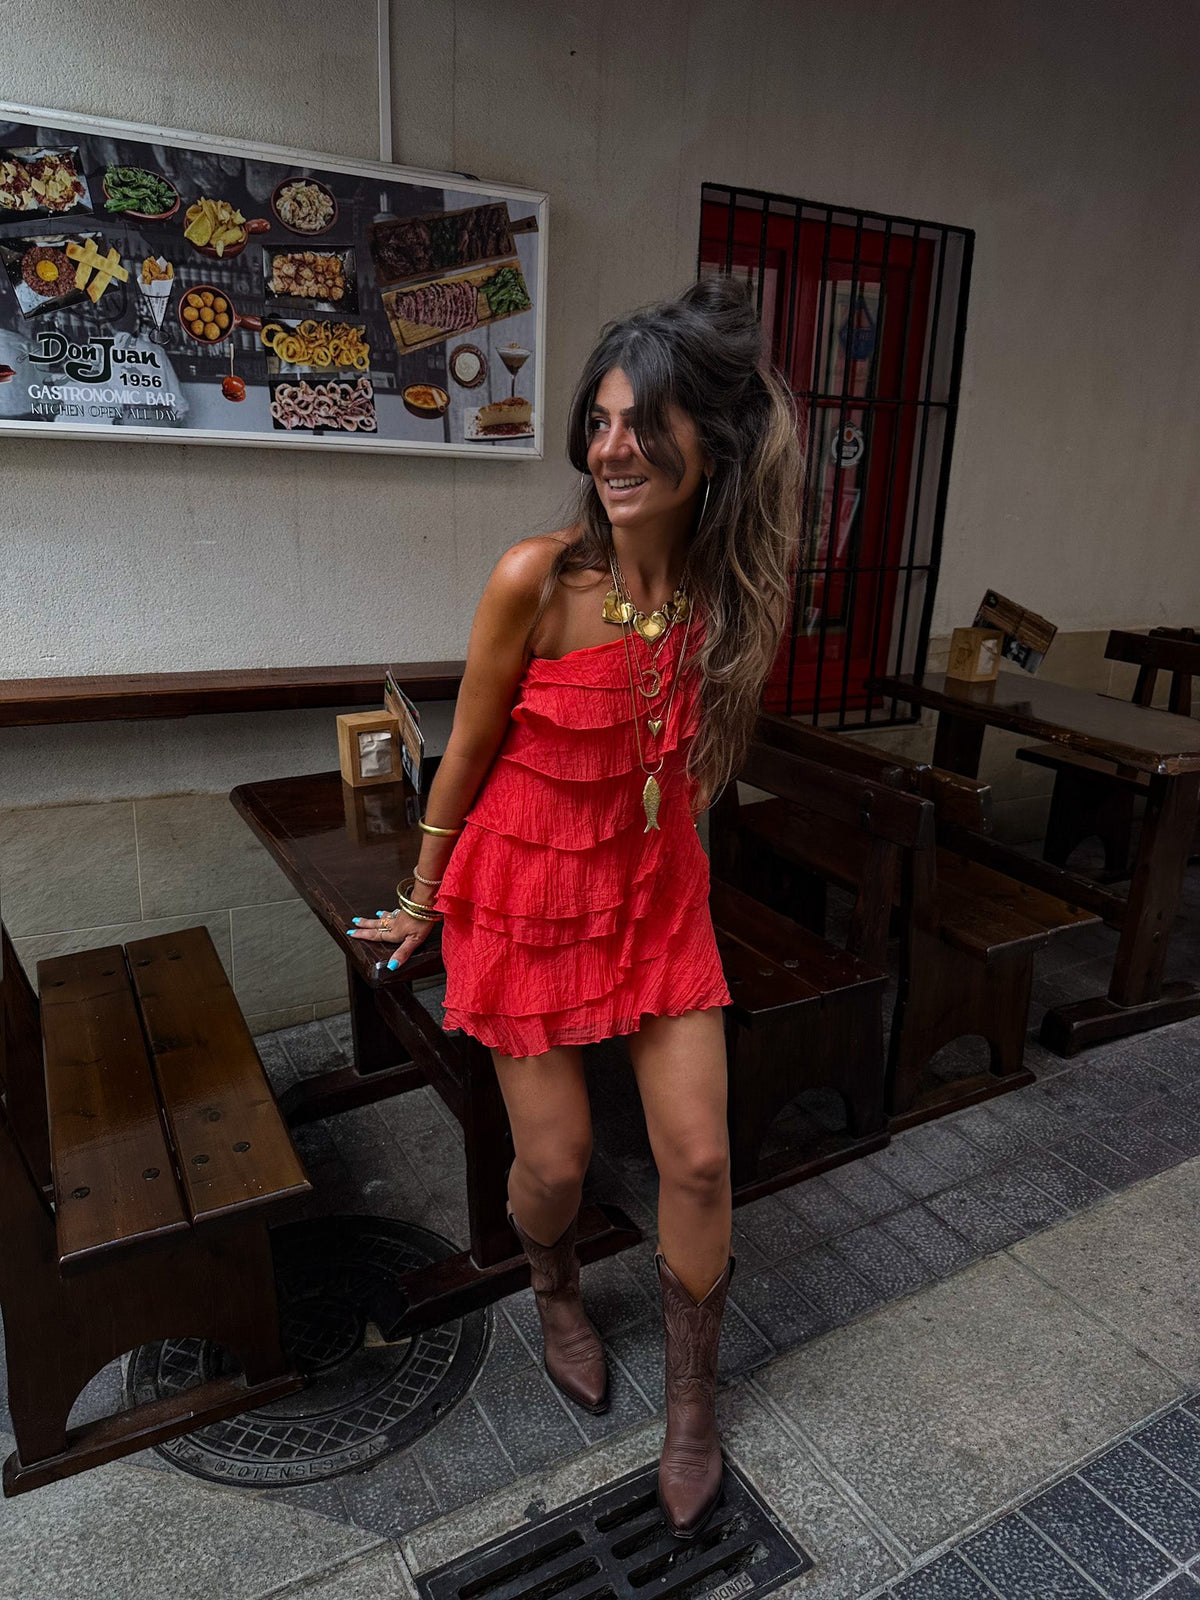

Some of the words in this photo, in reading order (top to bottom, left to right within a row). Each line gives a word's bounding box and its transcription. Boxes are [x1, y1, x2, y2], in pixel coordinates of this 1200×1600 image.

[29, 333, 97, 363] Don
[65, 338, 161, 383] Juan
[119, 373, 162, 388] 1956
[28, 385, 142, 405] GASTRONOMIC
[146, 391, 176, 406] BAR
[31, 403, 85, 417] KITCHEN
[88, 406, 123, 419] OPEN
[129, 408, 149, 421] ALL
[155, 410, 179, 421] DAY
